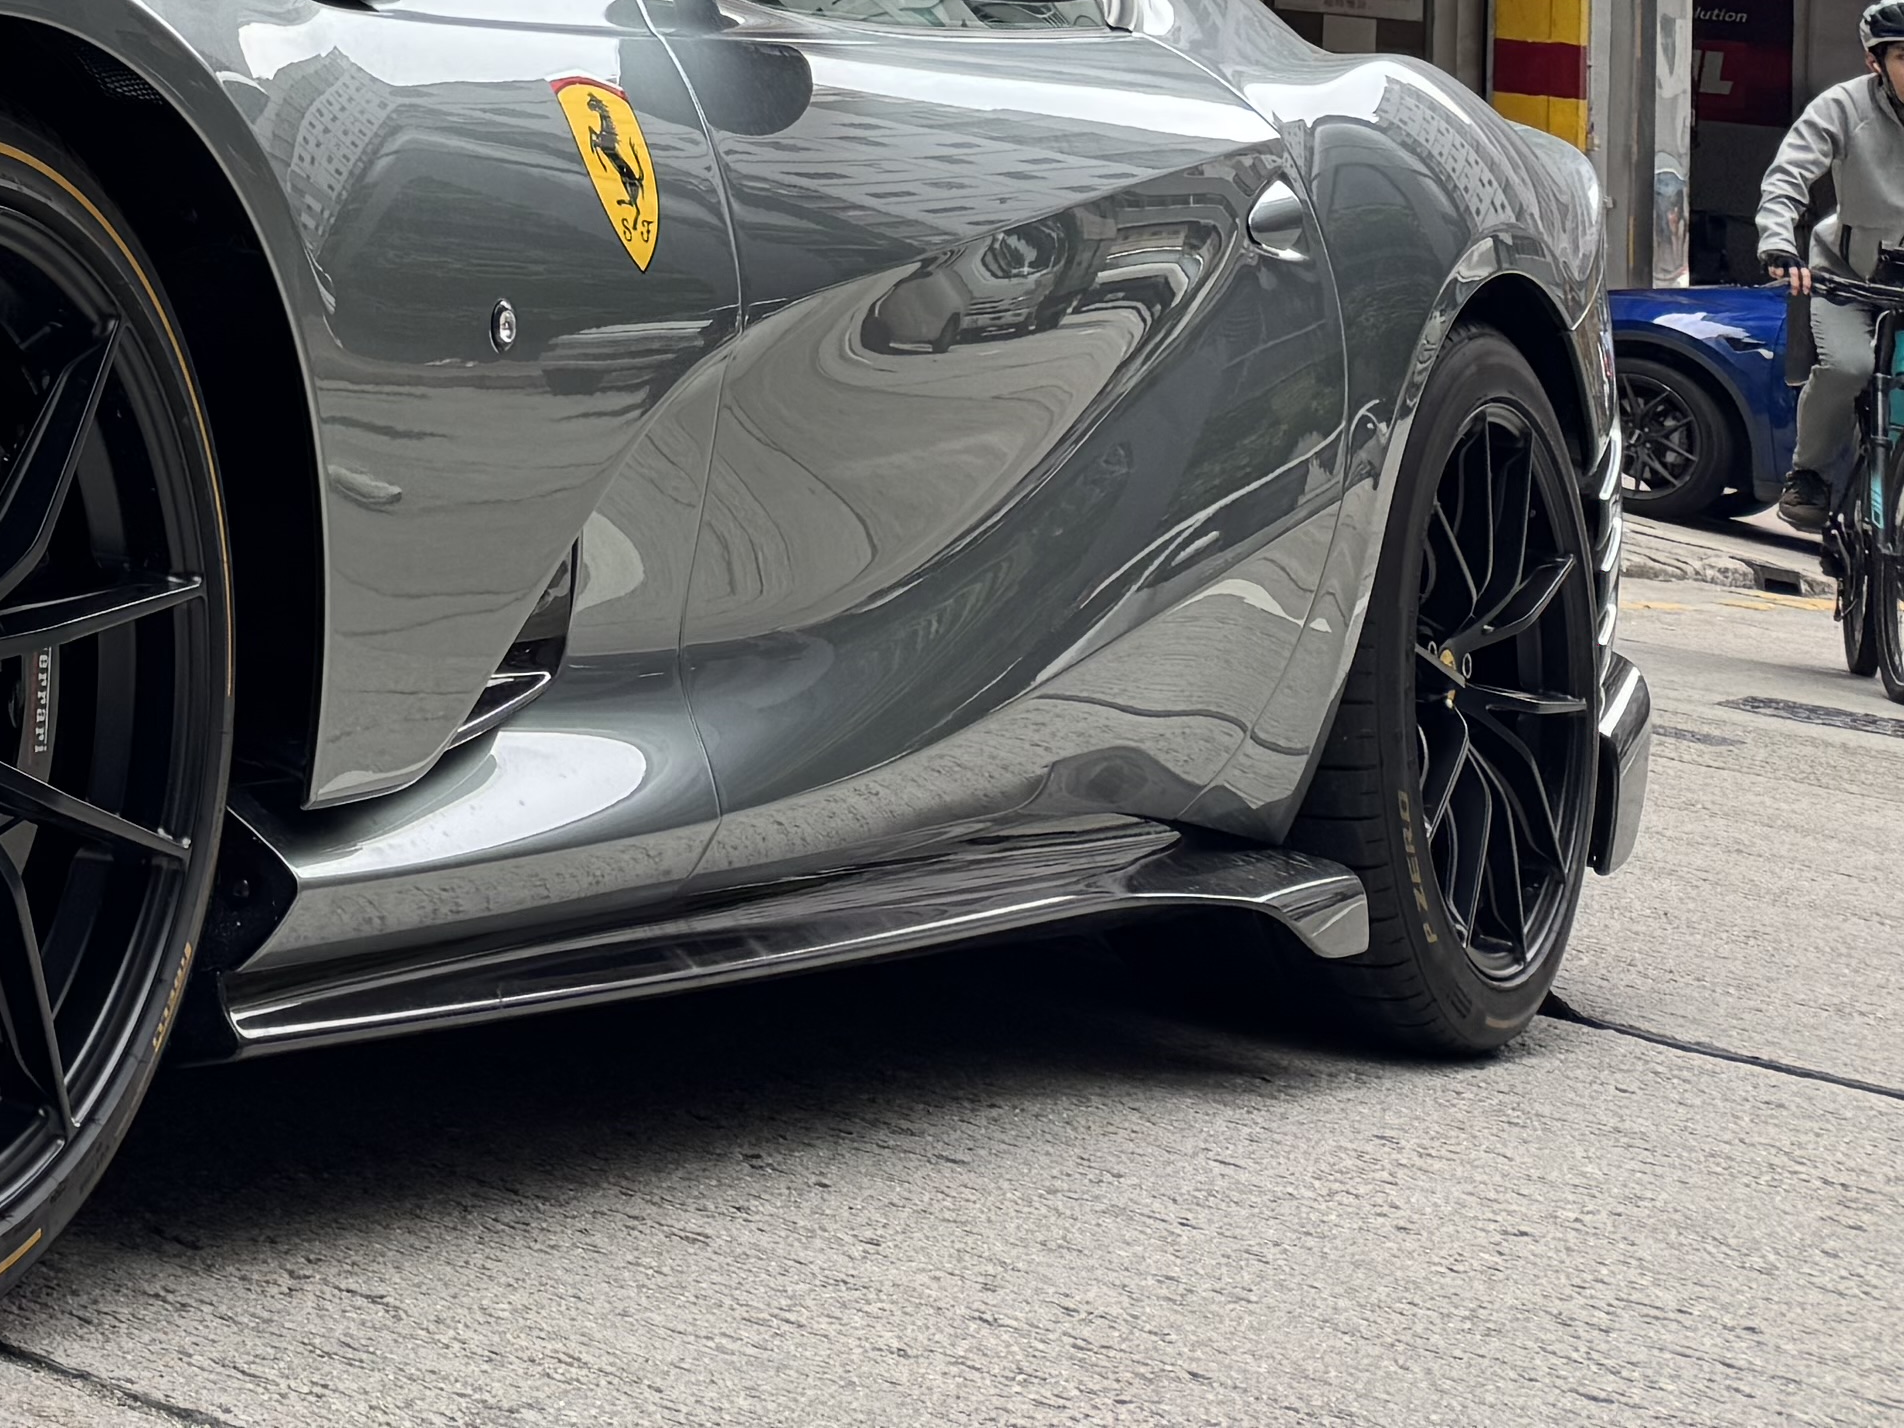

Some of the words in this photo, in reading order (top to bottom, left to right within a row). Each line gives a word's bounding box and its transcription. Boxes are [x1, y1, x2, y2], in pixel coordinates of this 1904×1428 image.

[621, 217, 633, 243] S
[640, 220, 654, 244] F
[33, 648, 52, 753] errari
[1397, 789, 1430, 914] ZERO
[1422, 921, 1439, 944] P
